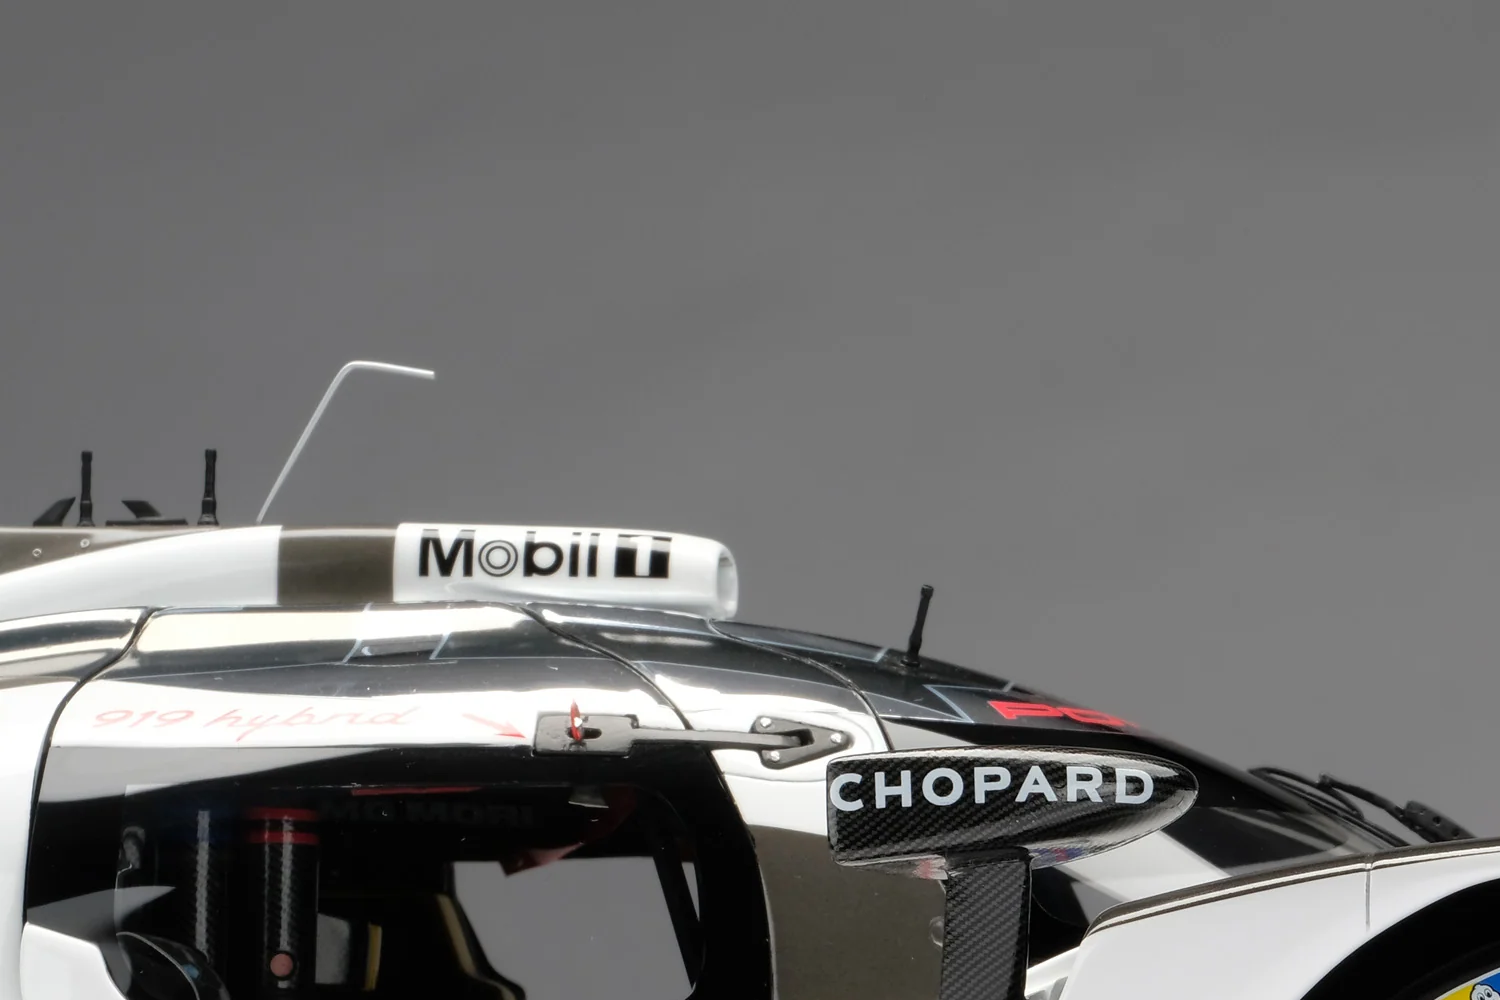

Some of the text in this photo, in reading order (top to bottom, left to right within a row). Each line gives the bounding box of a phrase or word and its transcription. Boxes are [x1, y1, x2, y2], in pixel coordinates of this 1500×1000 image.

[418, 528, 600, 578] Mobil
[92, 709, 196, 728] 919
[988, 700, 1141, 728] PO
[829, 765, 1154, 812] CHOPARD
